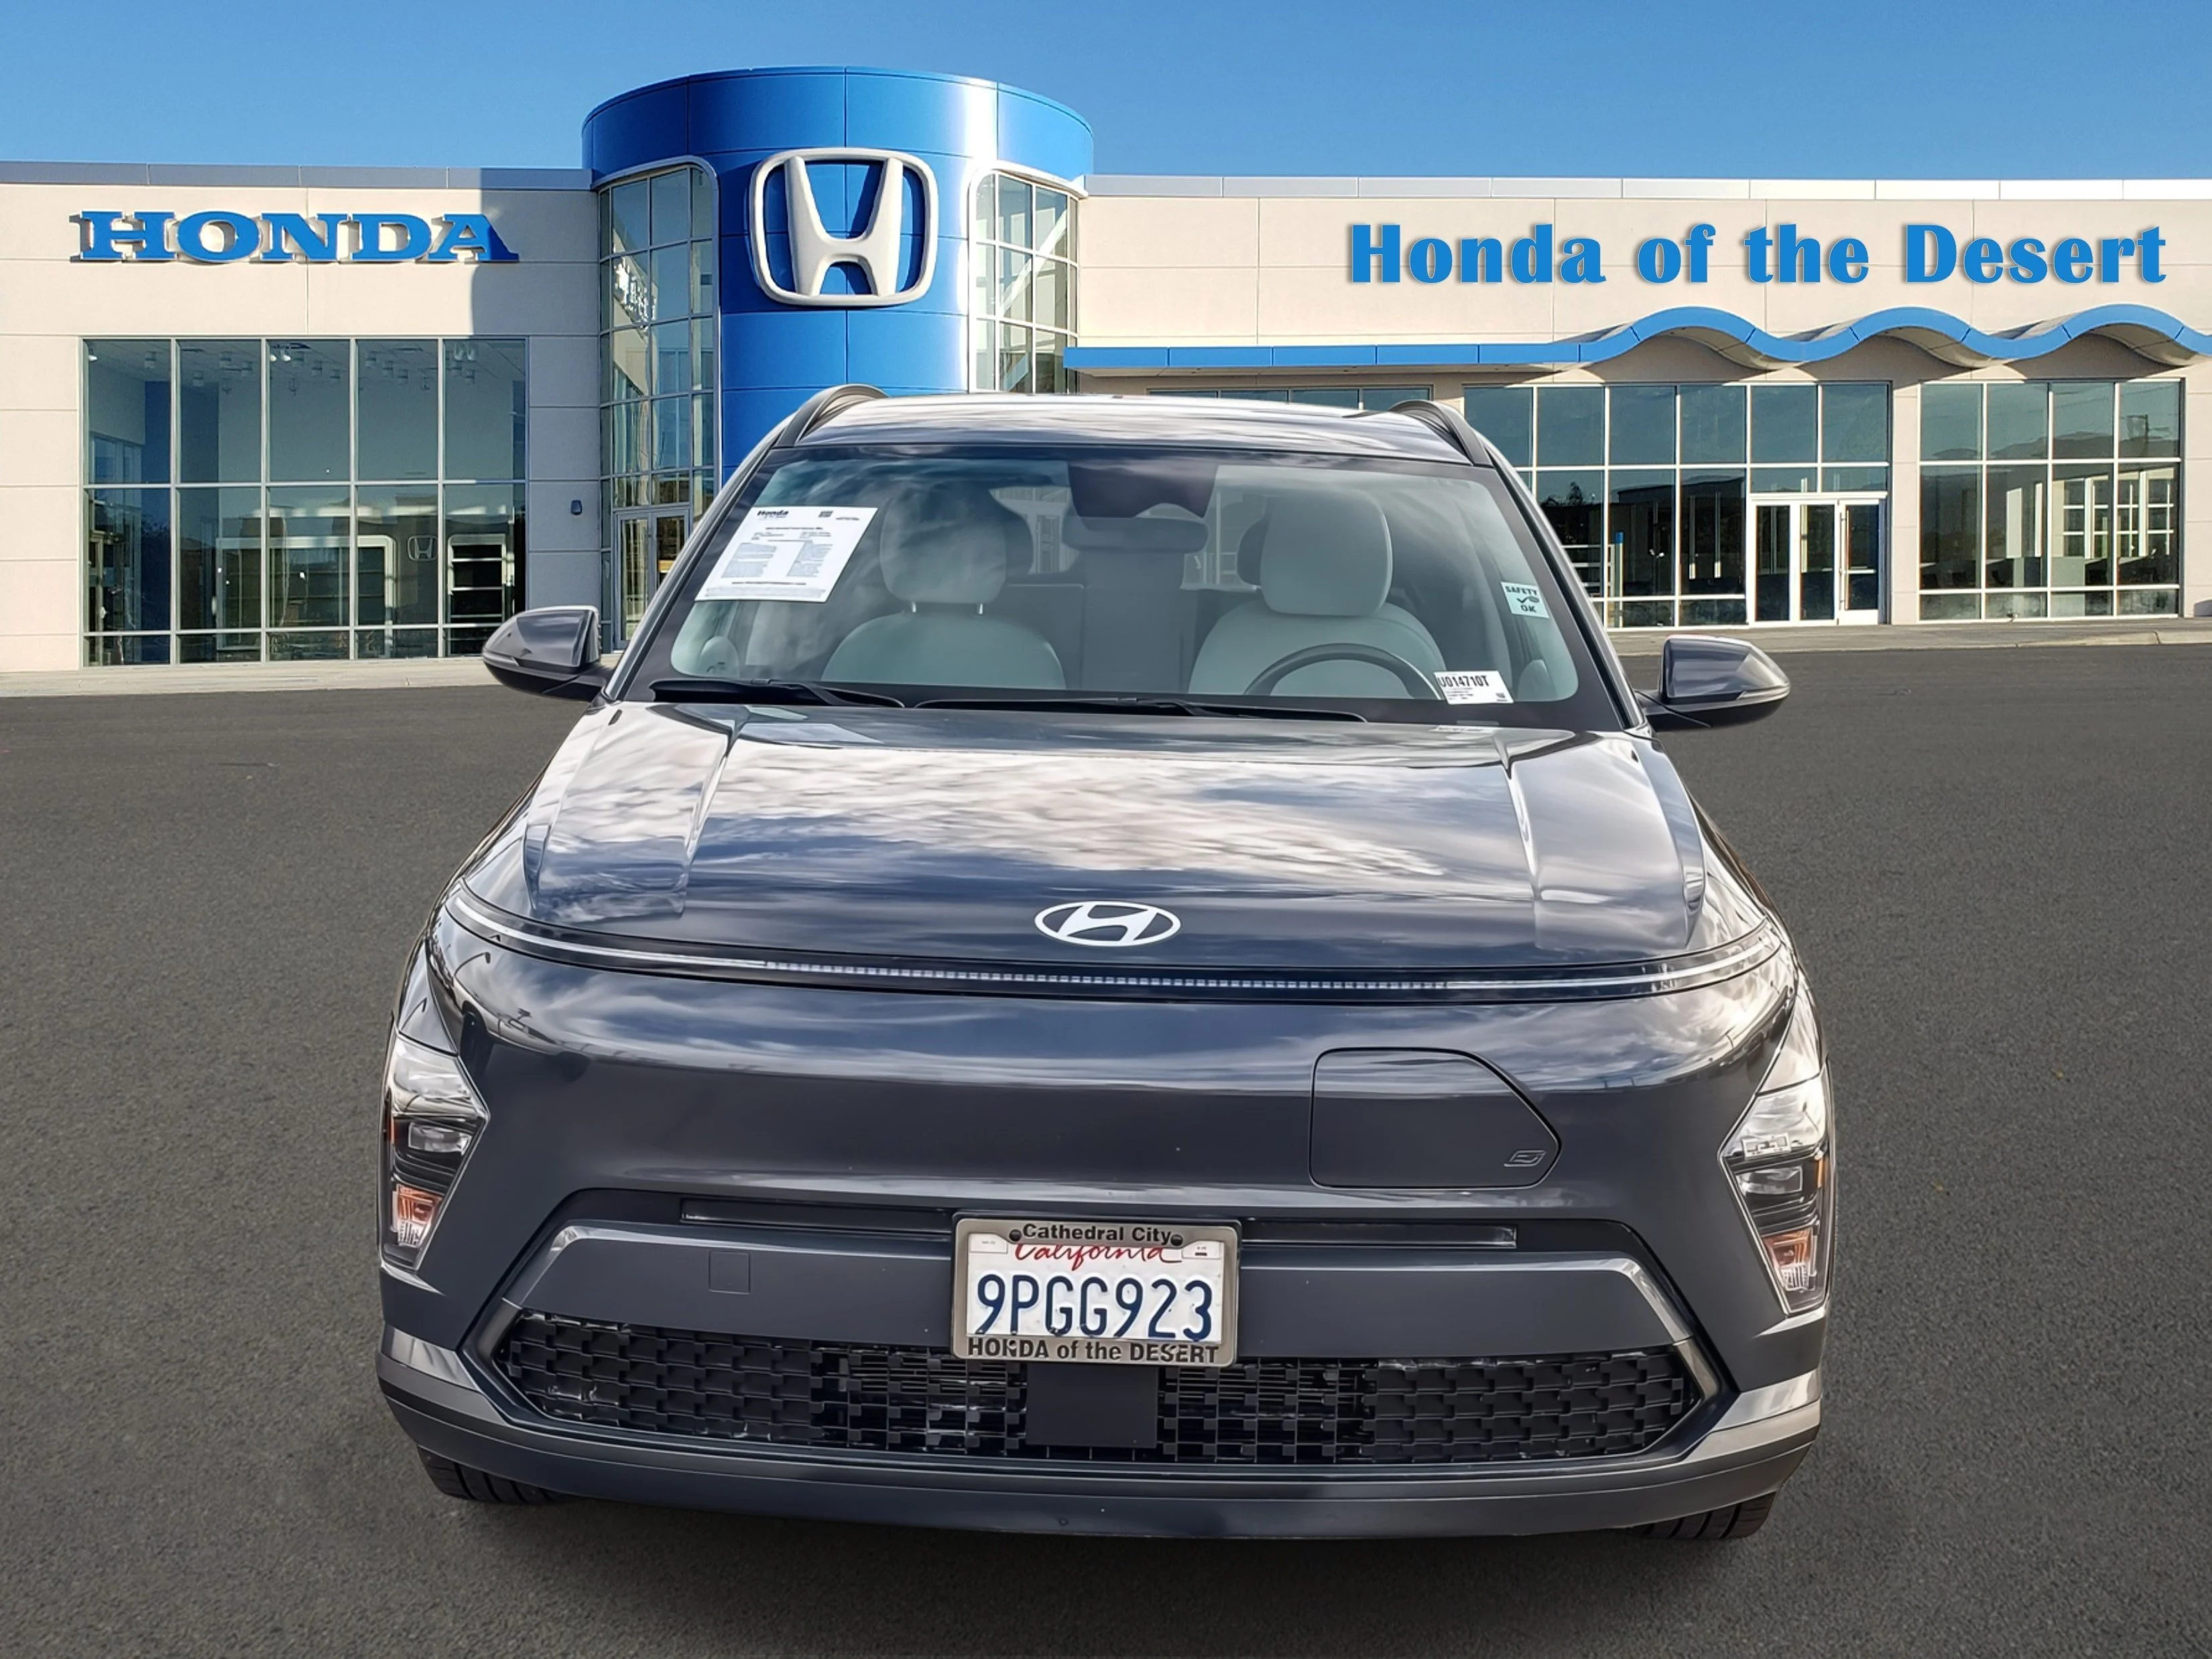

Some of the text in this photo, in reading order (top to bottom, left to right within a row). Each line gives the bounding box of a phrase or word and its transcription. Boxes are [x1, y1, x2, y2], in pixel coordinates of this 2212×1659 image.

[81, 210, 519, 262] HONDA
[1351, 223, 2166, 284] Honda of the Desert
[1505, 585, 1537, 595] SAFETY
[1520, 605, 1536, 613] OK
[1023, 1223, 1172, 1245] Cathedral City
[1015, 1243, 1182, 1271] California
[975, 1274, 1213, 1341] 9PGG923
[967, 1337, 1219, 1363] HONDA of the DESERT
